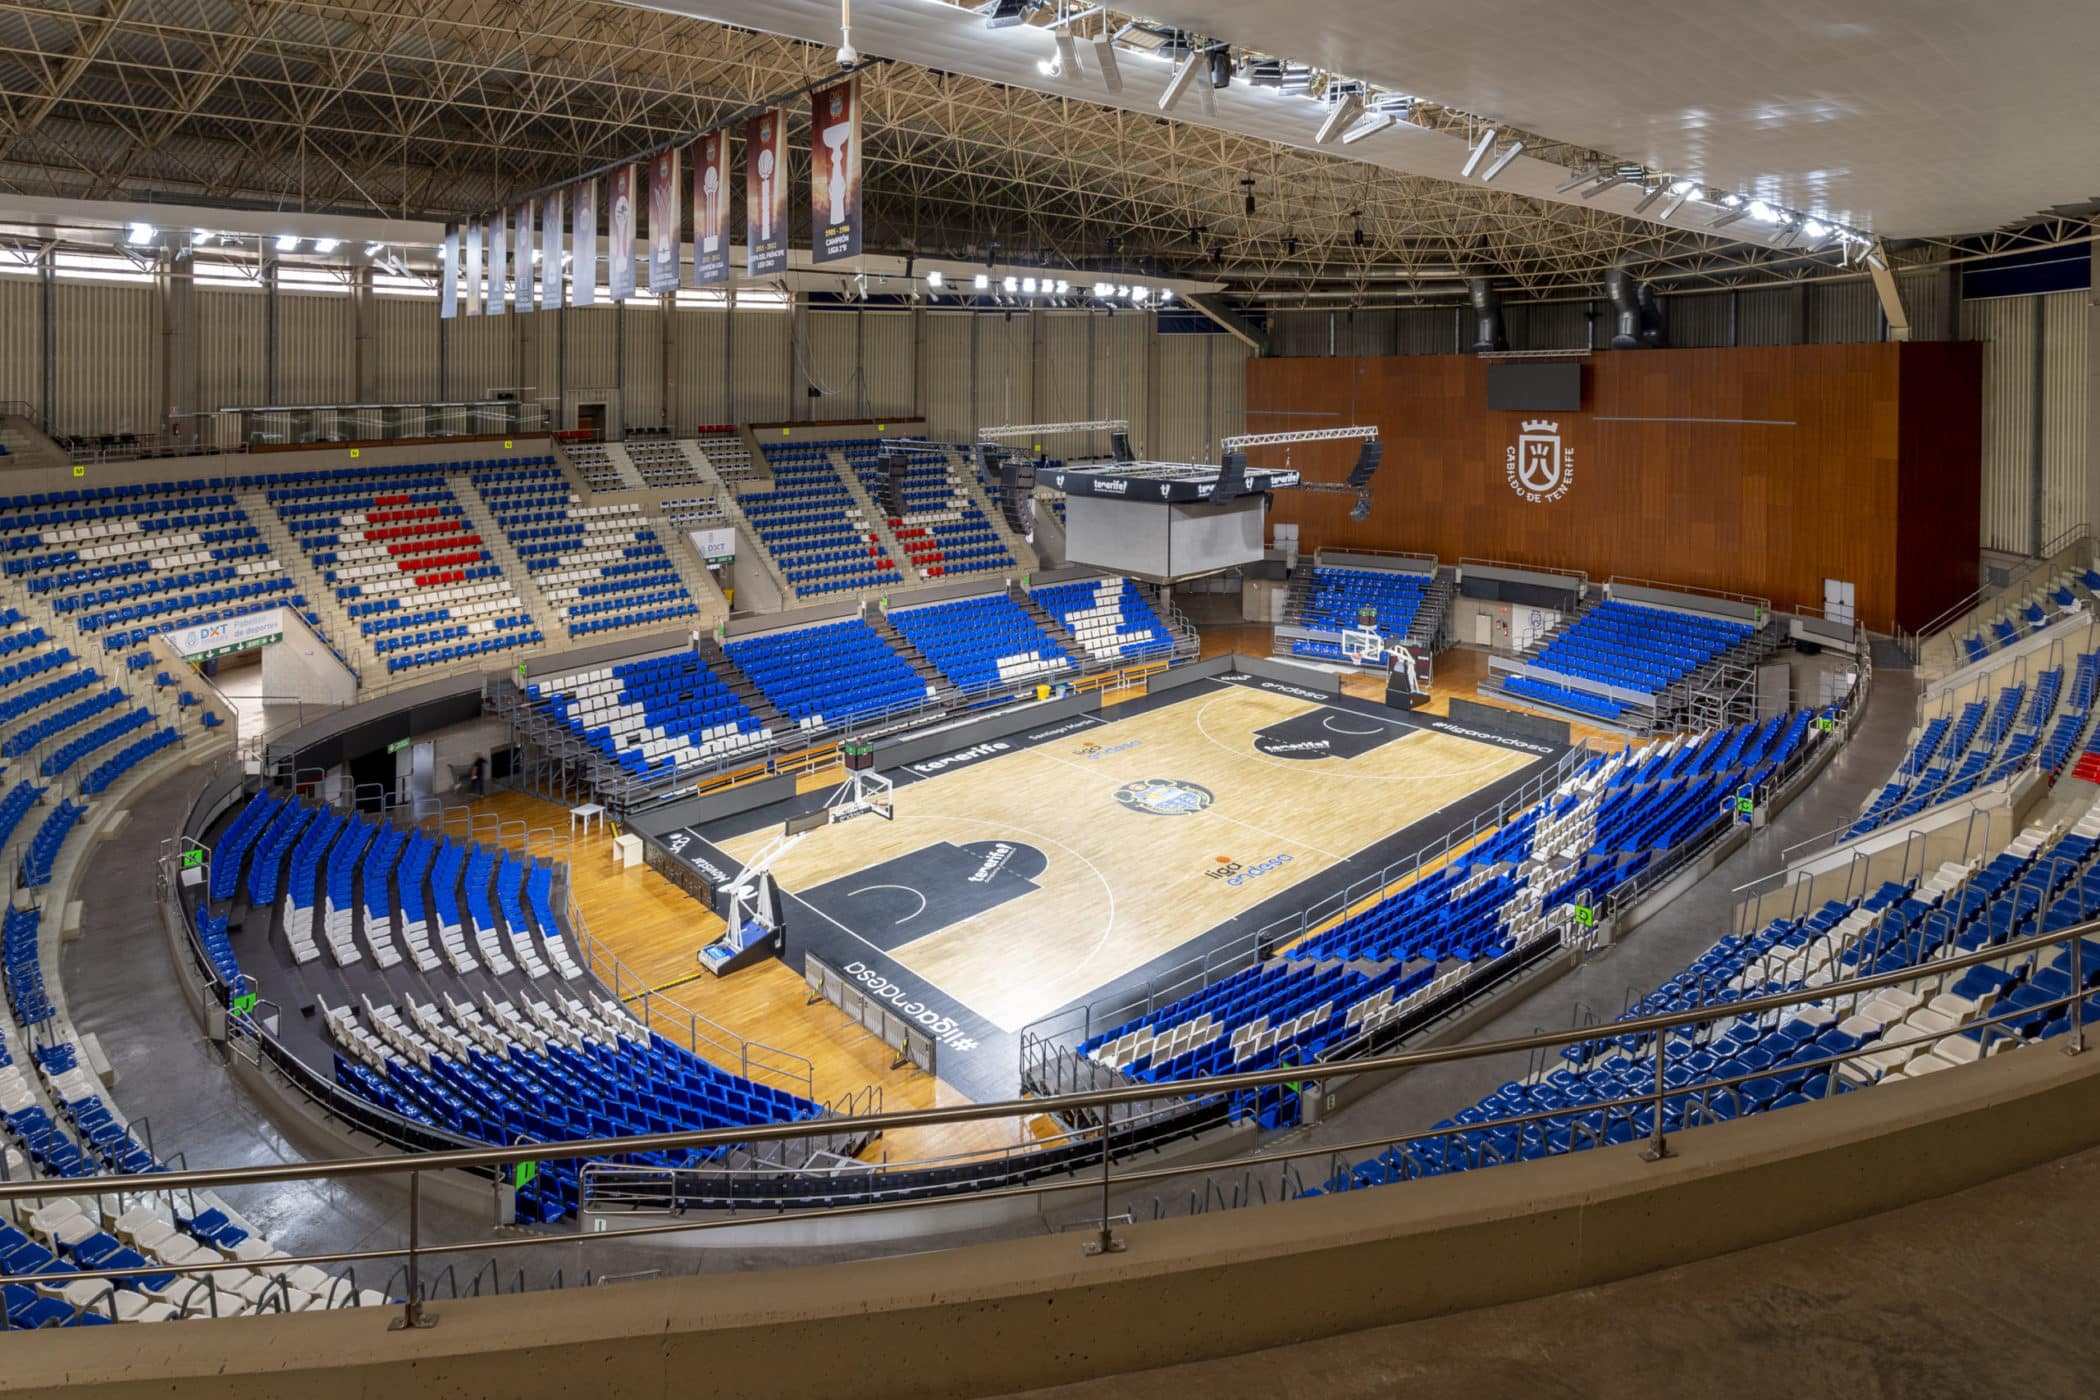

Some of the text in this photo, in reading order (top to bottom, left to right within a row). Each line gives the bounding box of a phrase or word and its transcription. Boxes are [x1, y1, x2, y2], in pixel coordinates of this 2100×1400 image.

[1506, 445, 1576, 503] CABILDO DE TENERIFE
[200, 623, 228, 639] DXT
[1261, 682, 1328, 700] endesa
[1432, 721, 1555, 754] #ligaendesa
[913, 741, 1011, 773] tenerife
[1205, 862, 1243, 880] liga
[1227, 853, 1295, 886] endesa
[843, 961, 981, 1052] #ligaendesa
